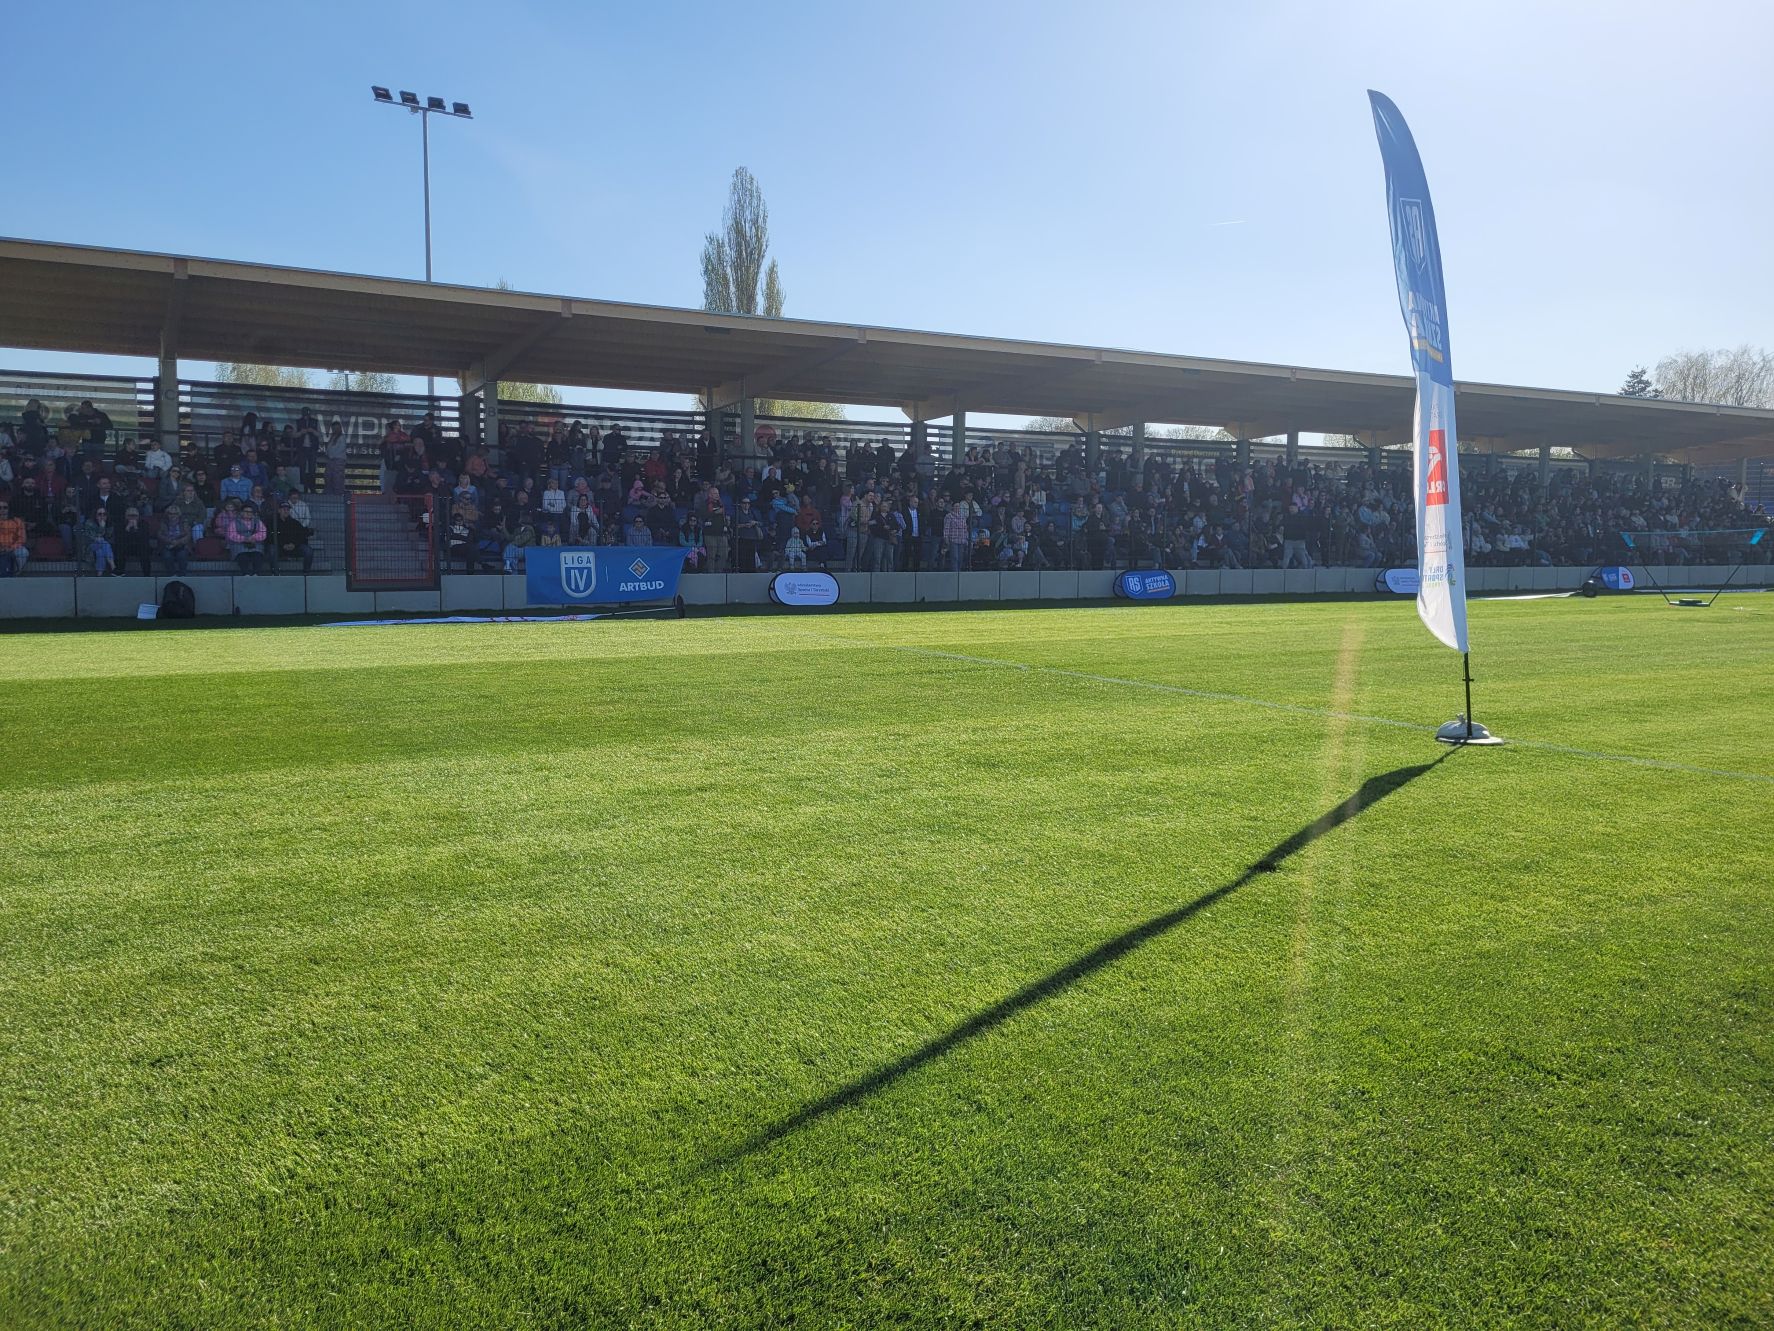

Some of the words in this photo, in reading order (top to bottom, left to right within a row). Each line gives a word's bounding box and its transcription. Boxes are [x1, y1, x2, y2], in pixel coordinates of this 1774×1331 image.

[563, 555, 592, 565] LIGA
[570, 569, 588, 591] IV
[619, 580, 665, 592] ARTBUD
